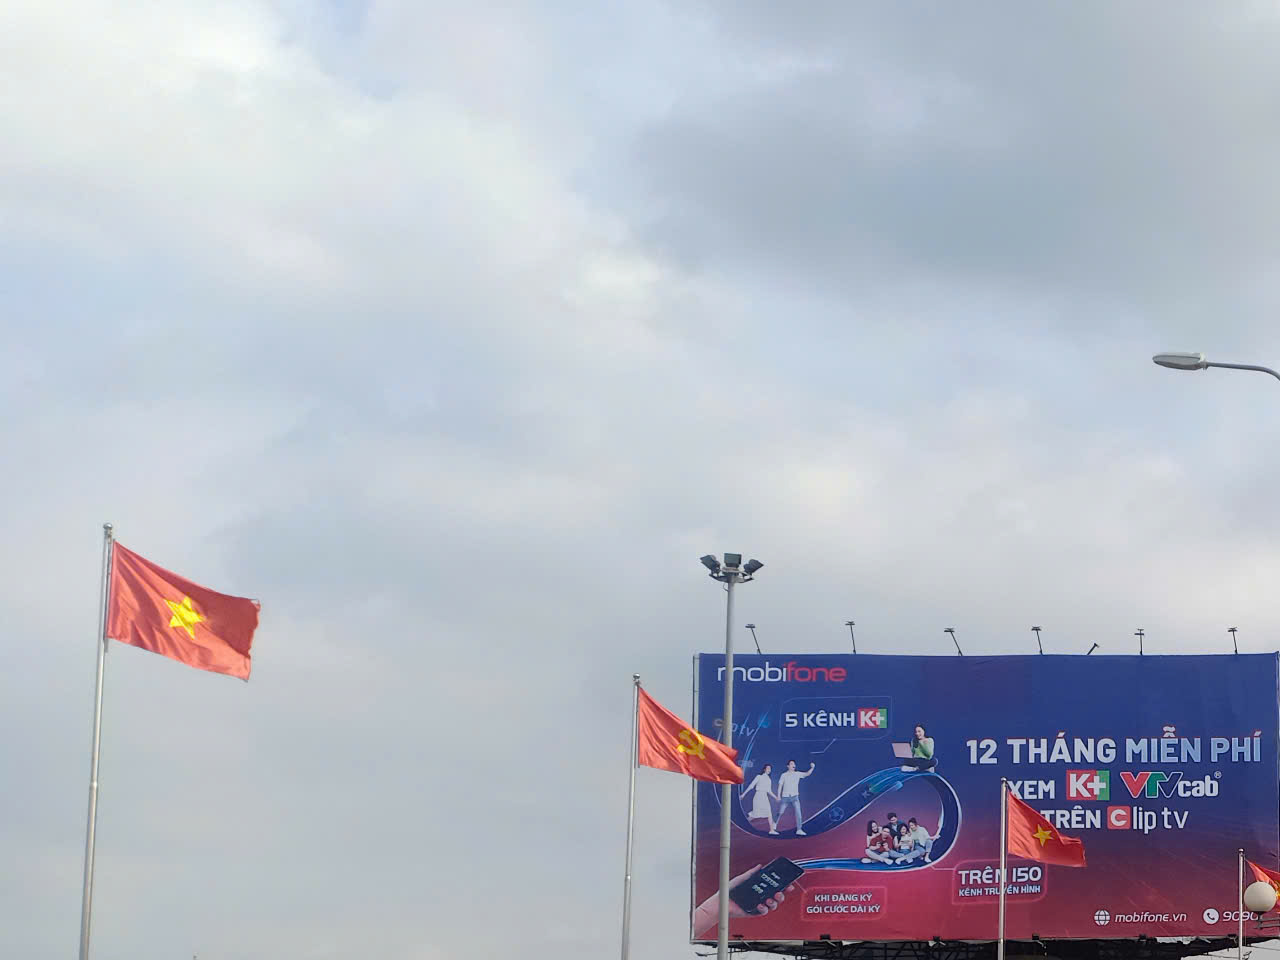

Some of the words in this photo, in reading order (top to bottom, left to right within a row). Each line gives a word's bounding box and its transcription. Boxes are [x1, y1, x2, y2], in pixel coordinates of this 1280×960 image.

[717, 662, 847, 682] mobifone
[785, 713, 798, 727] 5
[803, 710, 855, 727] KÊNH
[966, 738, 998, 764] 12
[1006, 731, 1116, 764] THÁNG
[1125, 726, 1201, 763] MIỄN
[1210, 731, 1262, 763] PHÍ
[1007, 780, 1055, 799] XEM
[1068, 771, 1108, 799] K+
[1041, 805, 1101, 829] TRÊN
[1161, 806, 1189, 829] tv
[814, 894, 830, 902] KHI
[832, 893, 858, 902] ĐĂNG
[860, 892, 872, 902] KÝ
[959, 887, 983, 897] KÊNH
[1021, 884, 1041, 894] HÌNH
[806, 905, 822, 914] GÓI
[824, 905, 848, 914] CƯỚC
[851, 905, 867, 913] DÀI
[1115, 911, 1187, 923] mobifone.vn
